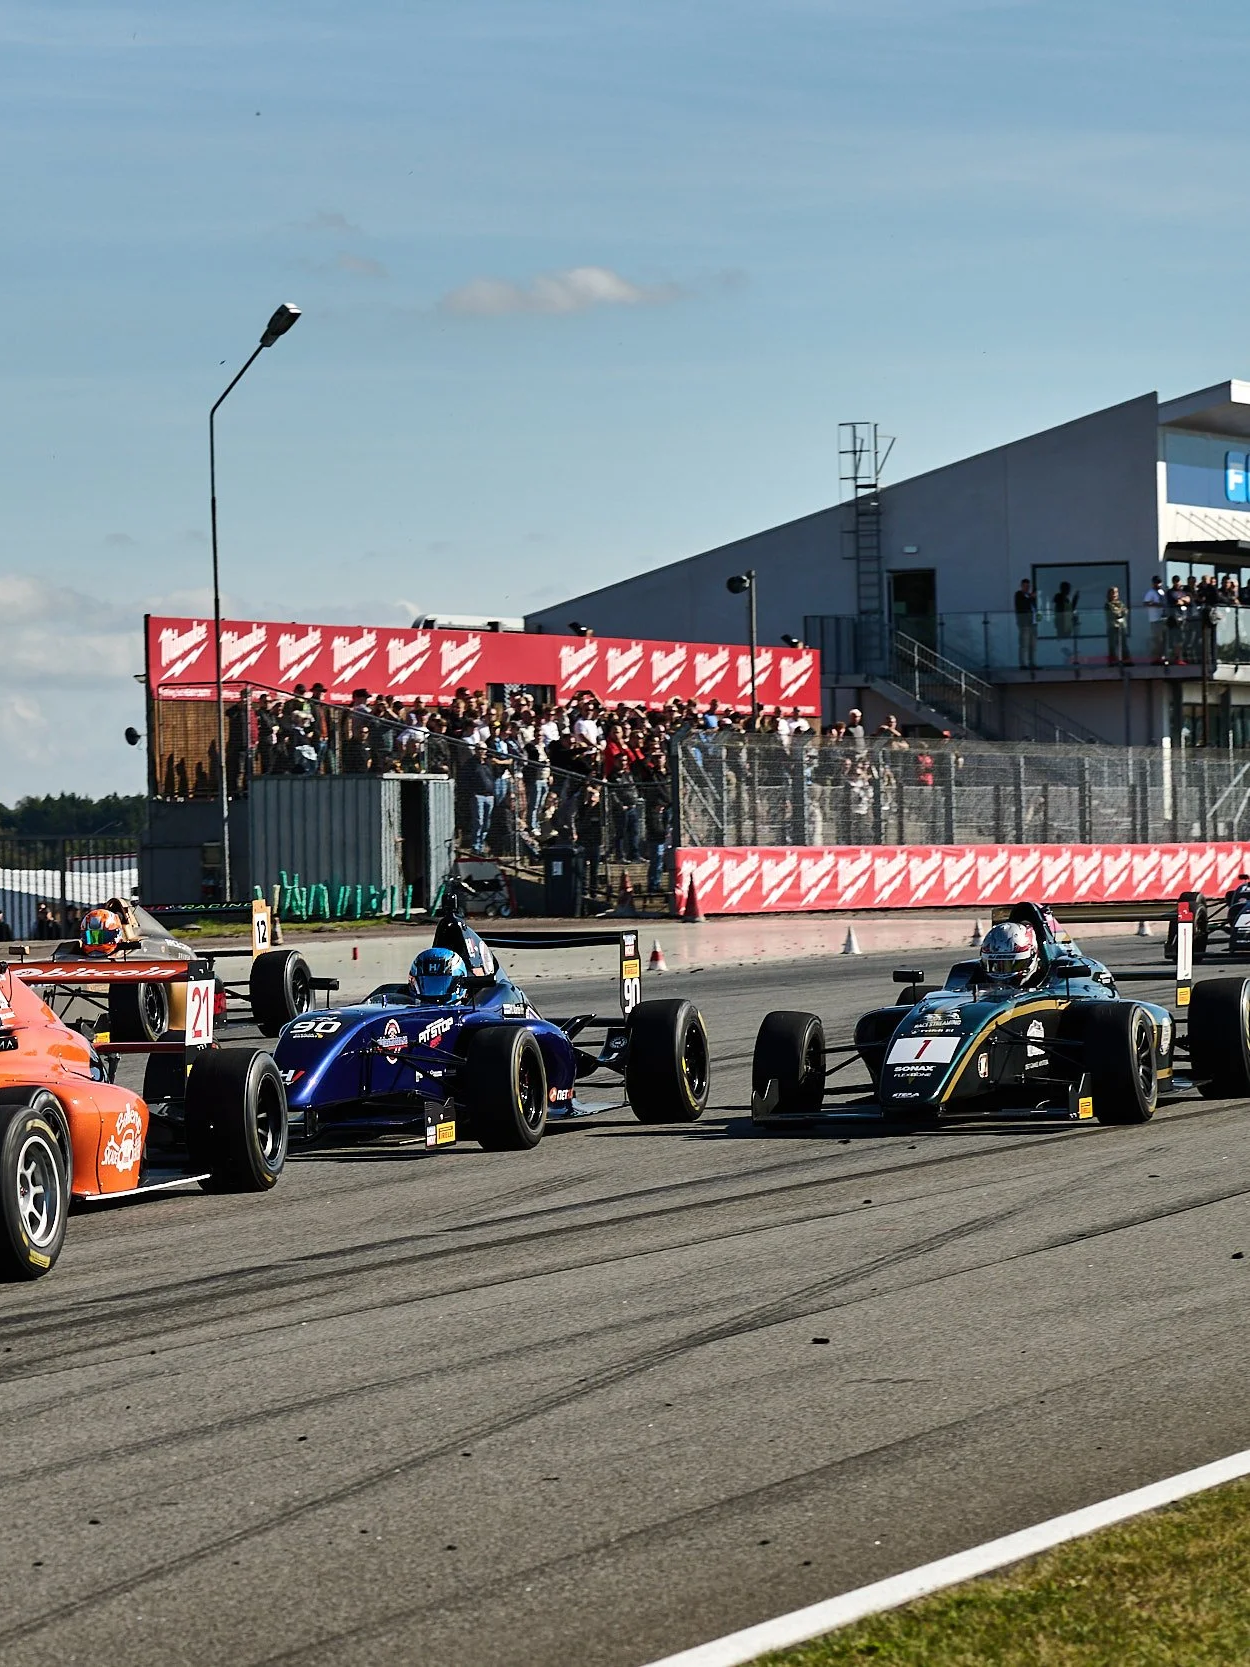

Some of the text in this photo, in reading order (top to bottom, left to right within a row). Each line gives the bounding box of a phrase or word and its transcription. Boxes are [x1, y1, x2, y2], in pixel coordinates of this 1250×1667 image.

[256, 920, 267, 944] 12
[42, 966, 176, 978] bitcoin
[624, 978, 641, 1014] 90
[192, 986, 209, 1038] 21
[290, 1021, 342, 1034] 90
[914, 1040, 932, 1060] 1
